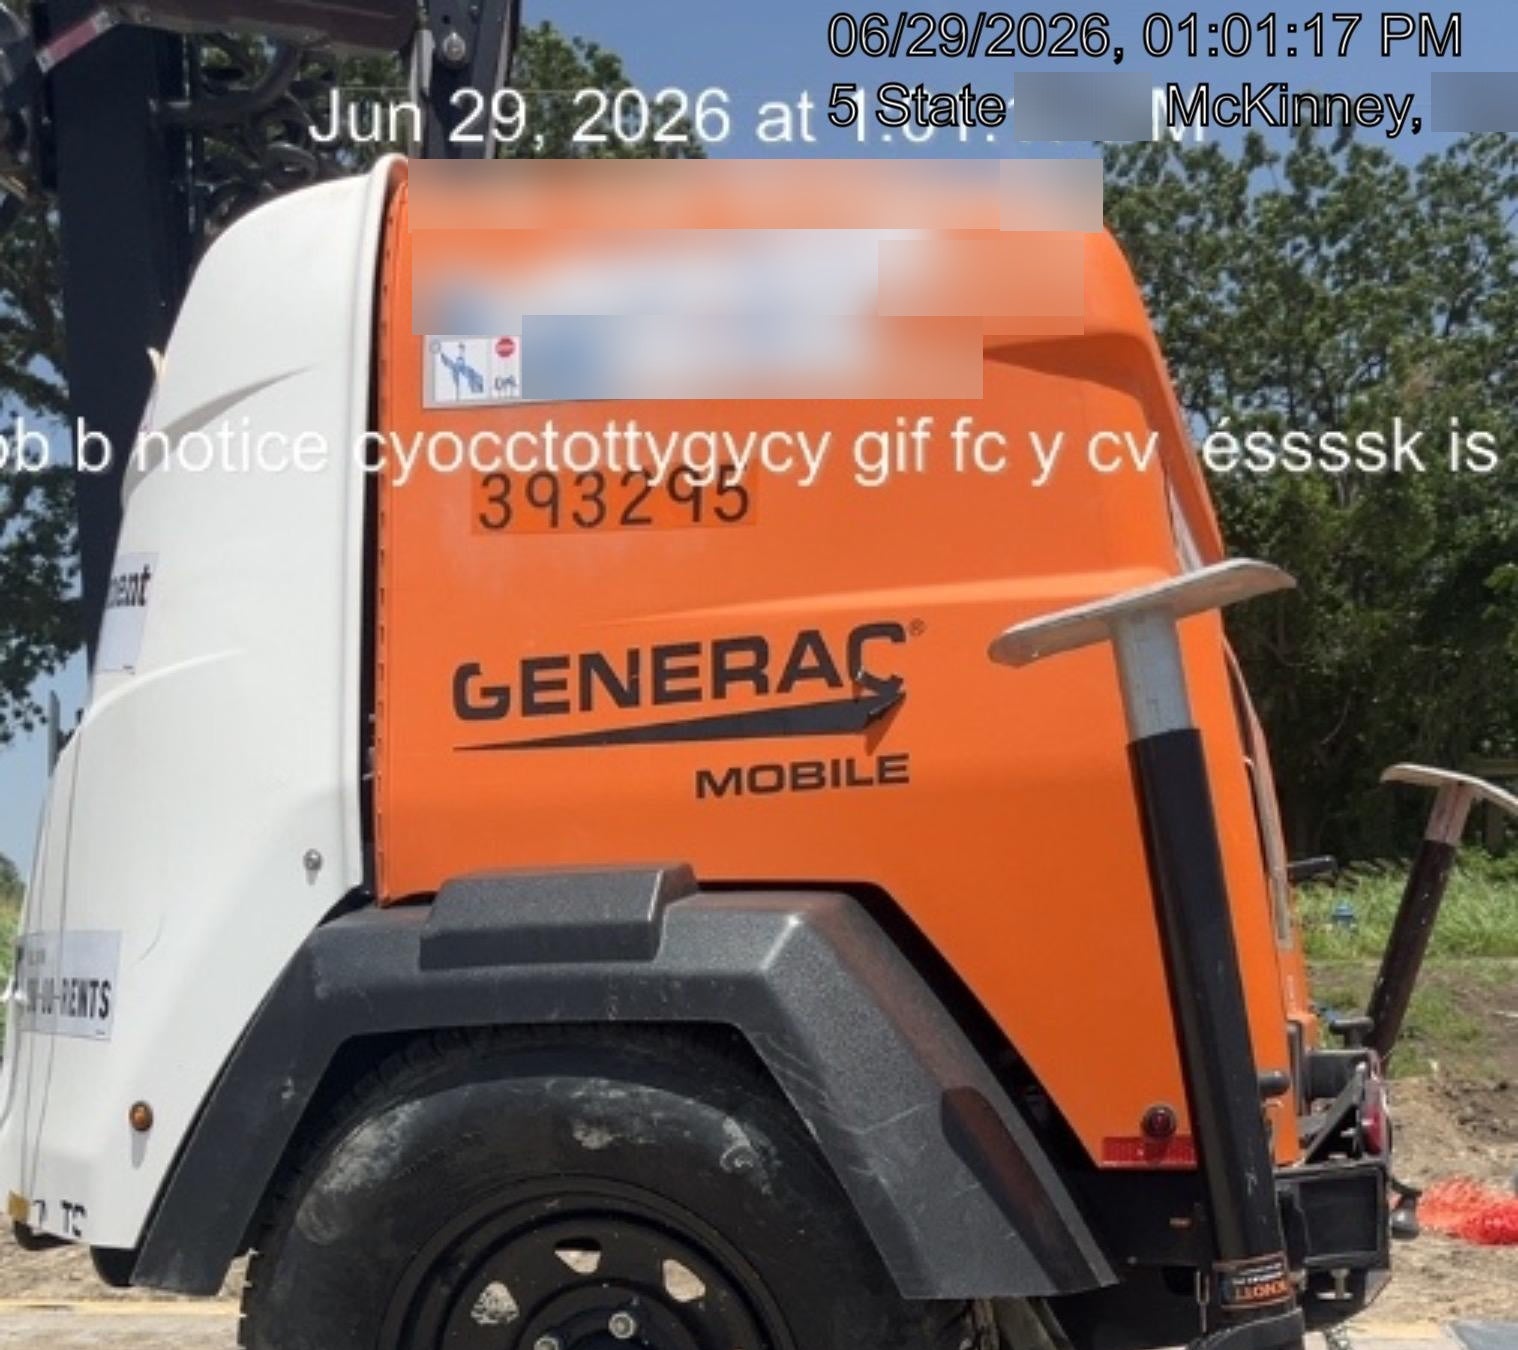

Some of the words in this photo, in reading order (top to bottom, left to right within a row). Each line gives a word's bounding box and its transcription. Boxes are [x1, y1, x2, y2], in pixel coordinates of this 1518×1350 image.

[478, 464, 750, 530] 393295
[452, 620, 908, 721] GENERAC
[695, 753, 910, 800] MOBILE
